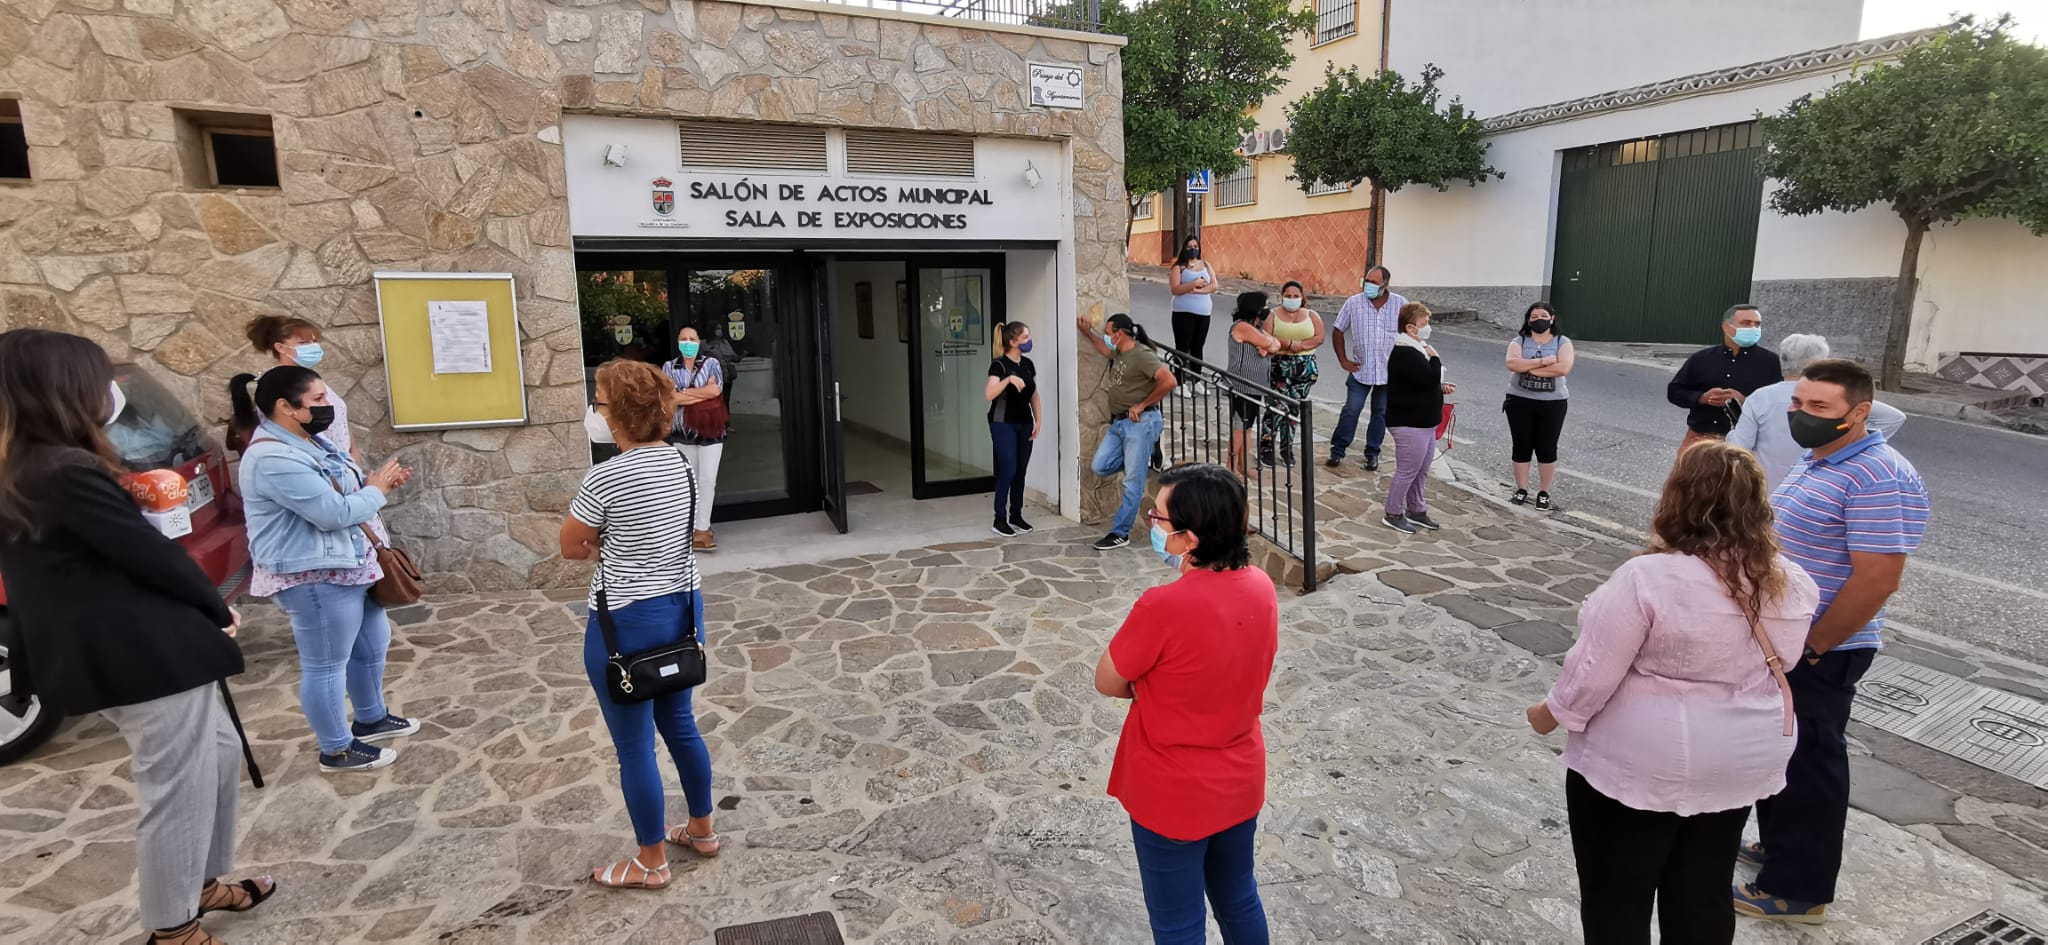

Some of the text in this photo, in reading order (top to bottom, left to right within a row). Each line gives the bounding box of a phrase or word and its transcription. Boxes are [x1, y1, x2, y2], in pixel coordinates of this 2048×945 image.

[690, 177, 993, 205] SALÓN DE ACTOS MUNICIPAL
[725, 209, 967, 229] SALA DE EXPOSICIONES
